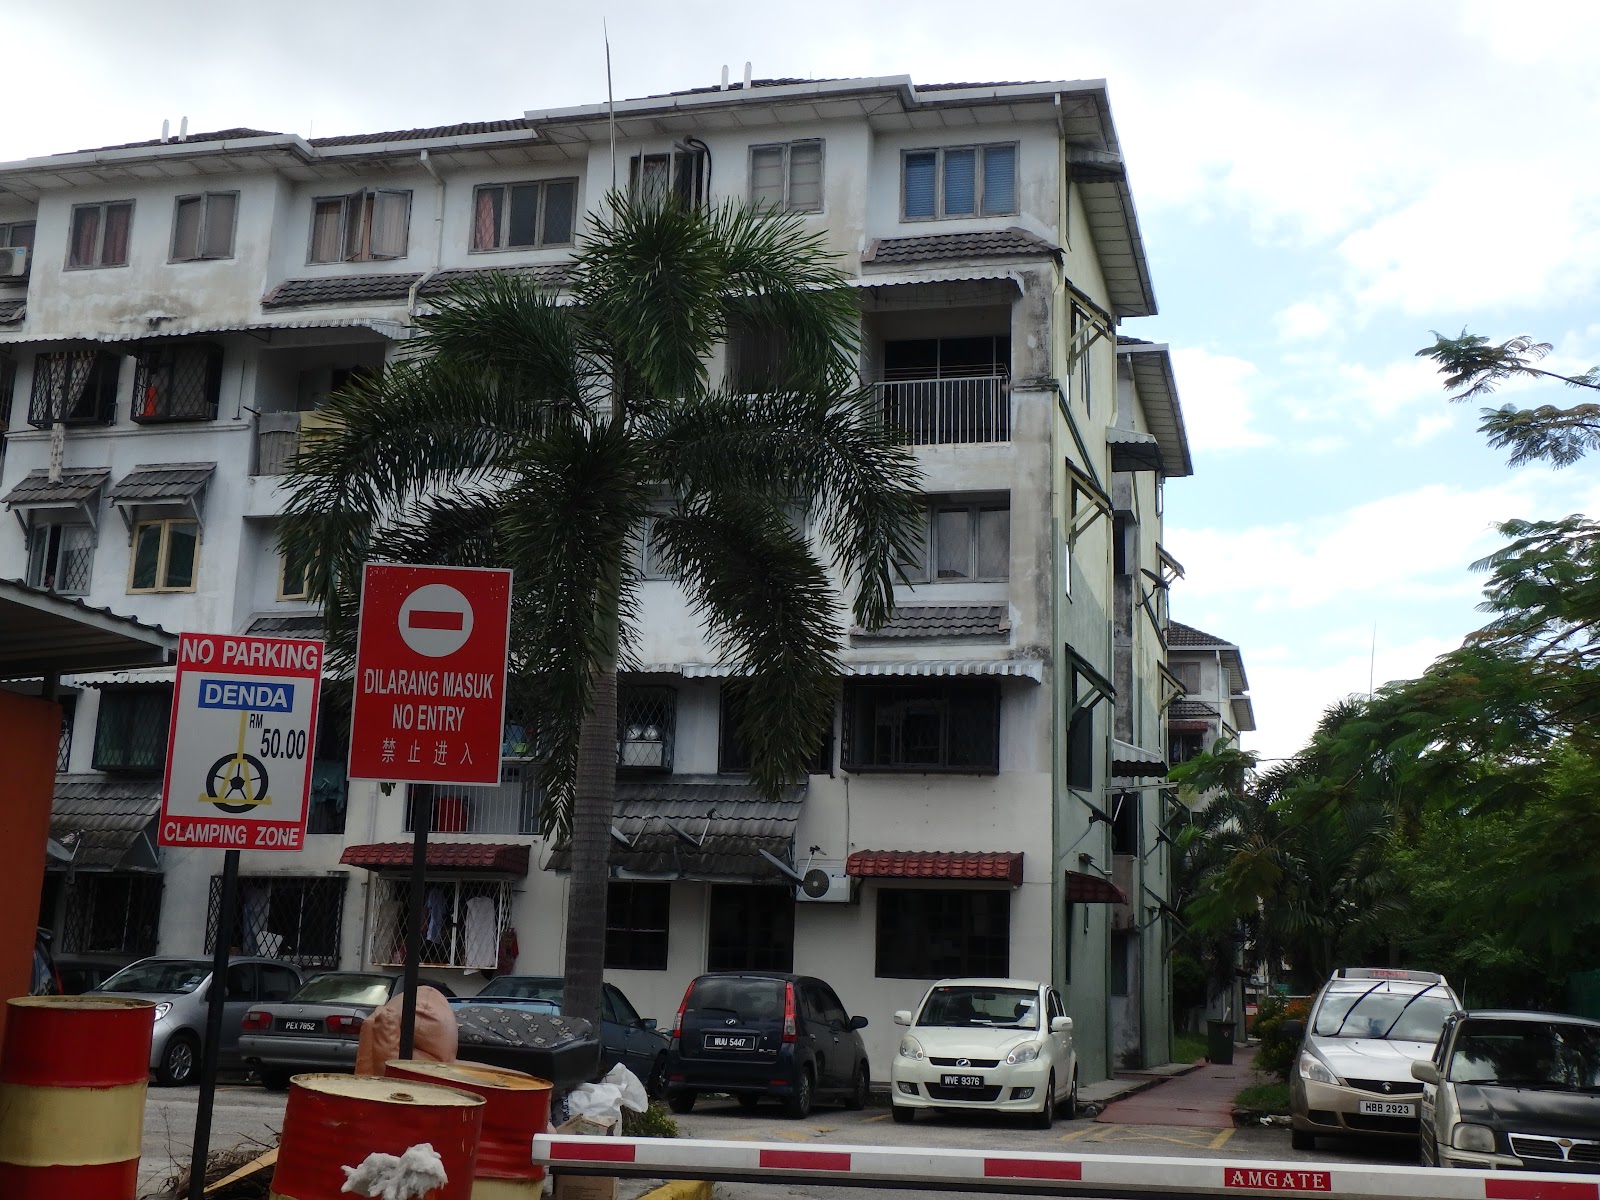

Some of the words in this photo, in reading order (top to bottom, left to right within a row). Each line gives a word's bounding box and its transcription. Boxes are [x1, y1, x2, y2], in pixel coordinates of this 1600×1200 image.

[181, 638, 215, 664] NO
[222, 640, 318, 670] PARKING
[364, 668, 439, 696] DILARANG
[442, 672, 494, 699] MASUK
[204, 683, 288, 708] DENDA
[249, 713, 263, 729] RM
[392, 703, 414, 730] NO
[417, 704, 465, 732] ENTRY
[260, 728, 306, 760] 50.00
[163, 821, 248, 845] CLAMPING
[254, 826, 300, 846] ZONE
[285, 1021, 299, 1030] PEX
[729, 1038, 746, 1047] 5447
[944, 1075, 959, 1085] WVE
[960, 1076, 980, 1086] 9376
[1365, 1102, 1383, 1113] HBB
[1385, 1104, 1409, 1114] 2923
[1231, 1170, 1325, 1189] AMGATE
